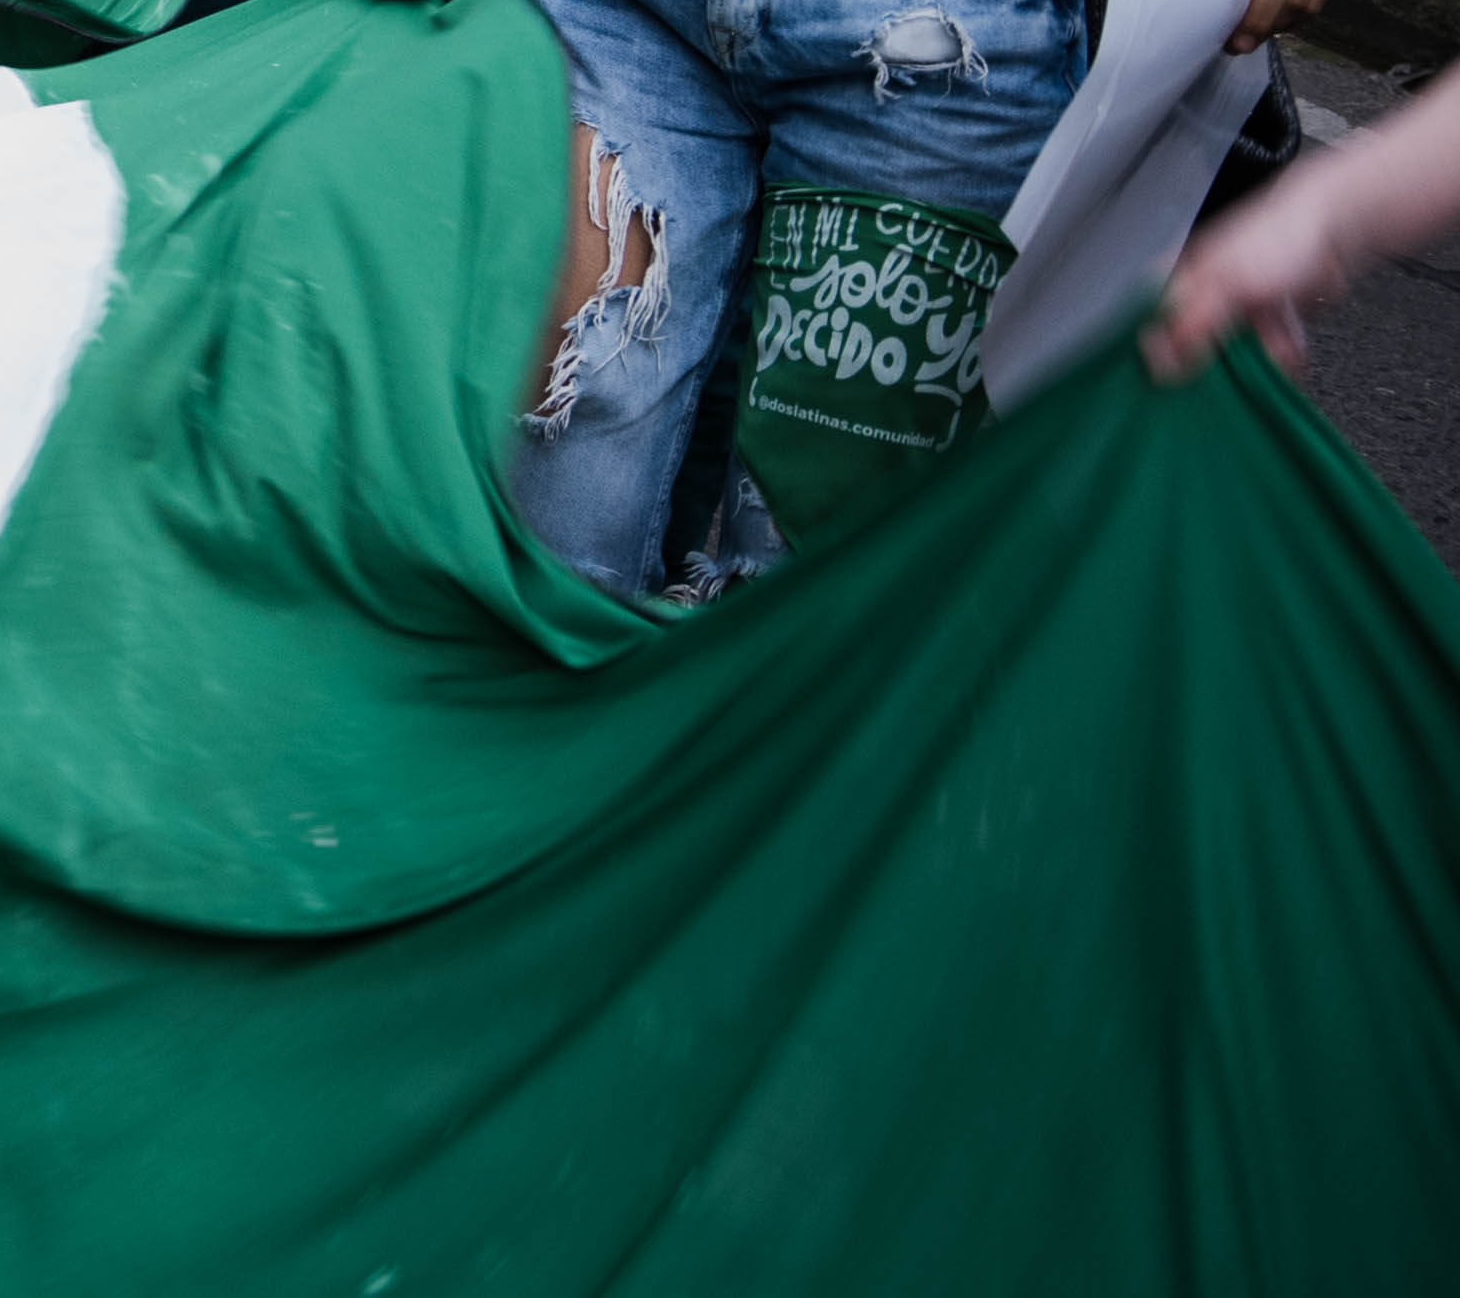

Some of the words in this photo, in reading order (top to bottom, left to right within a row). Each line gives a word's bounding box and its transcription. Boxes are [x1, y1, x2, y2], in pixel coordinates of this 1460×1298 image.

[811, 195, 860, 265] MI
[788, 242, 954, 327] solo
[757, 394, 937, 450] @doslatinas.comunidad
